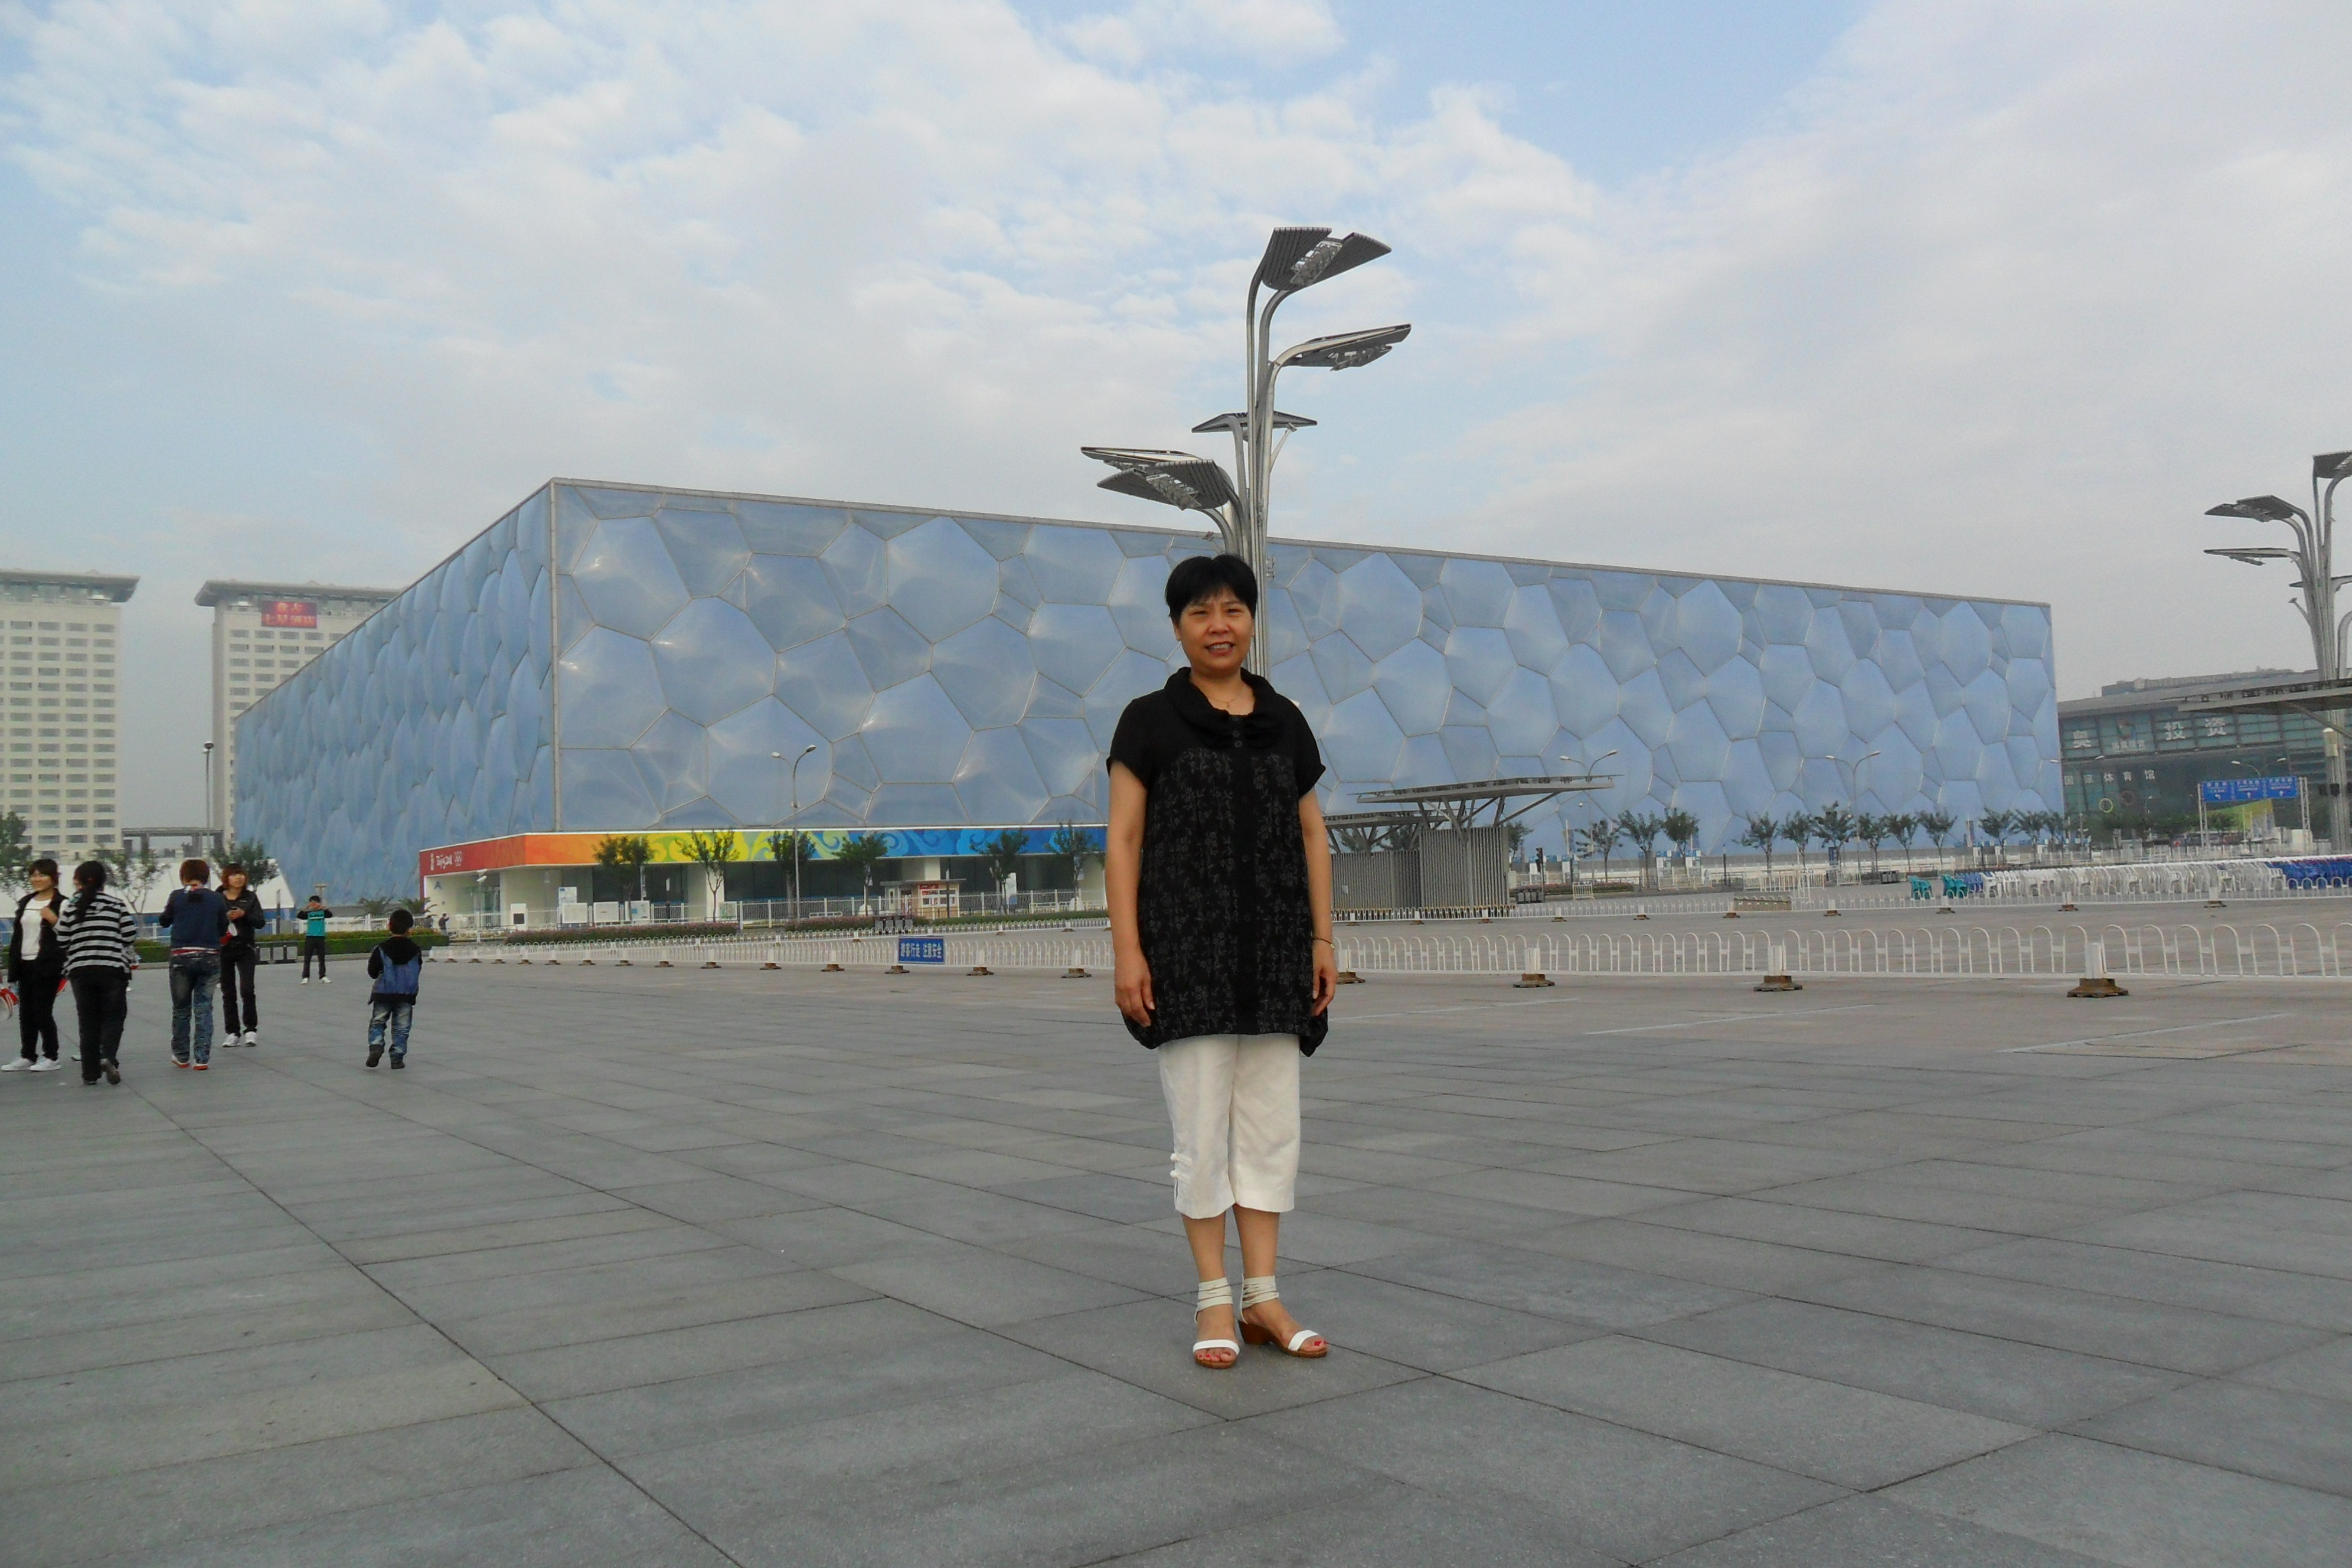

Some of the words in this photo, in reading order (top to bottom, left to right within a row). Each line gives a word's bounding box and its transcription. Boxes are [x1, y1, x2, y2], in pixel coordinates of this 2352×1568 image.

[2164, 717, 2226, 741] 投资
[2064, 769, 2155, 786] 国家体育馆
[434, 881, 442, 890] A
[900, 942, 920, 958] 游客行走
[923, 942, 942, 959] 注意安全
